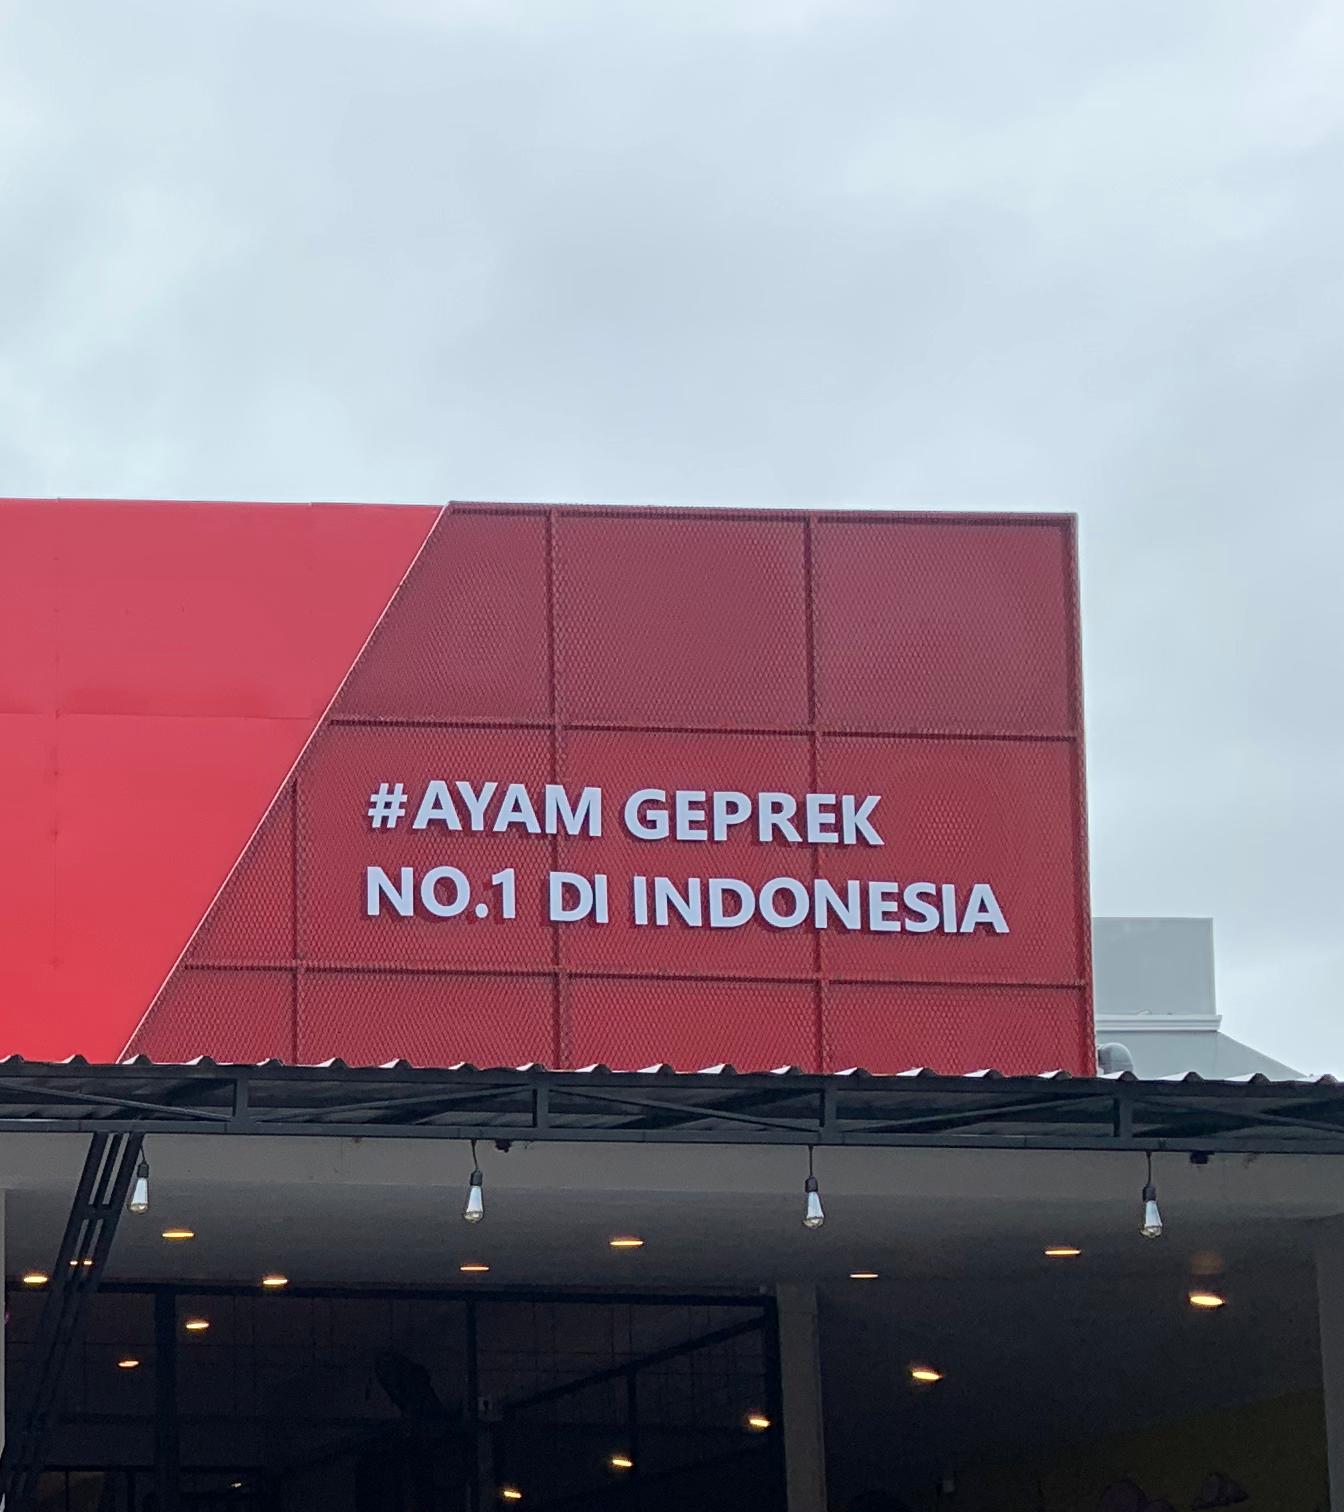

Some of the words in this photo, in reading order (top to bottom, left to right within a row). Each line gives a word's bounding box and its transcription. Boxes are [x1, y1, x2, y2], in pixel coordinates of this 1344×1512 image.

[367, 780, 603, 837] #AYAM
[624, 789, 885, 845] GEPREK
[366, 865, 516, 919] NO.1
[548, 871, 609, 924] DI
[634, 875, 1009, 934] INDONESIA
